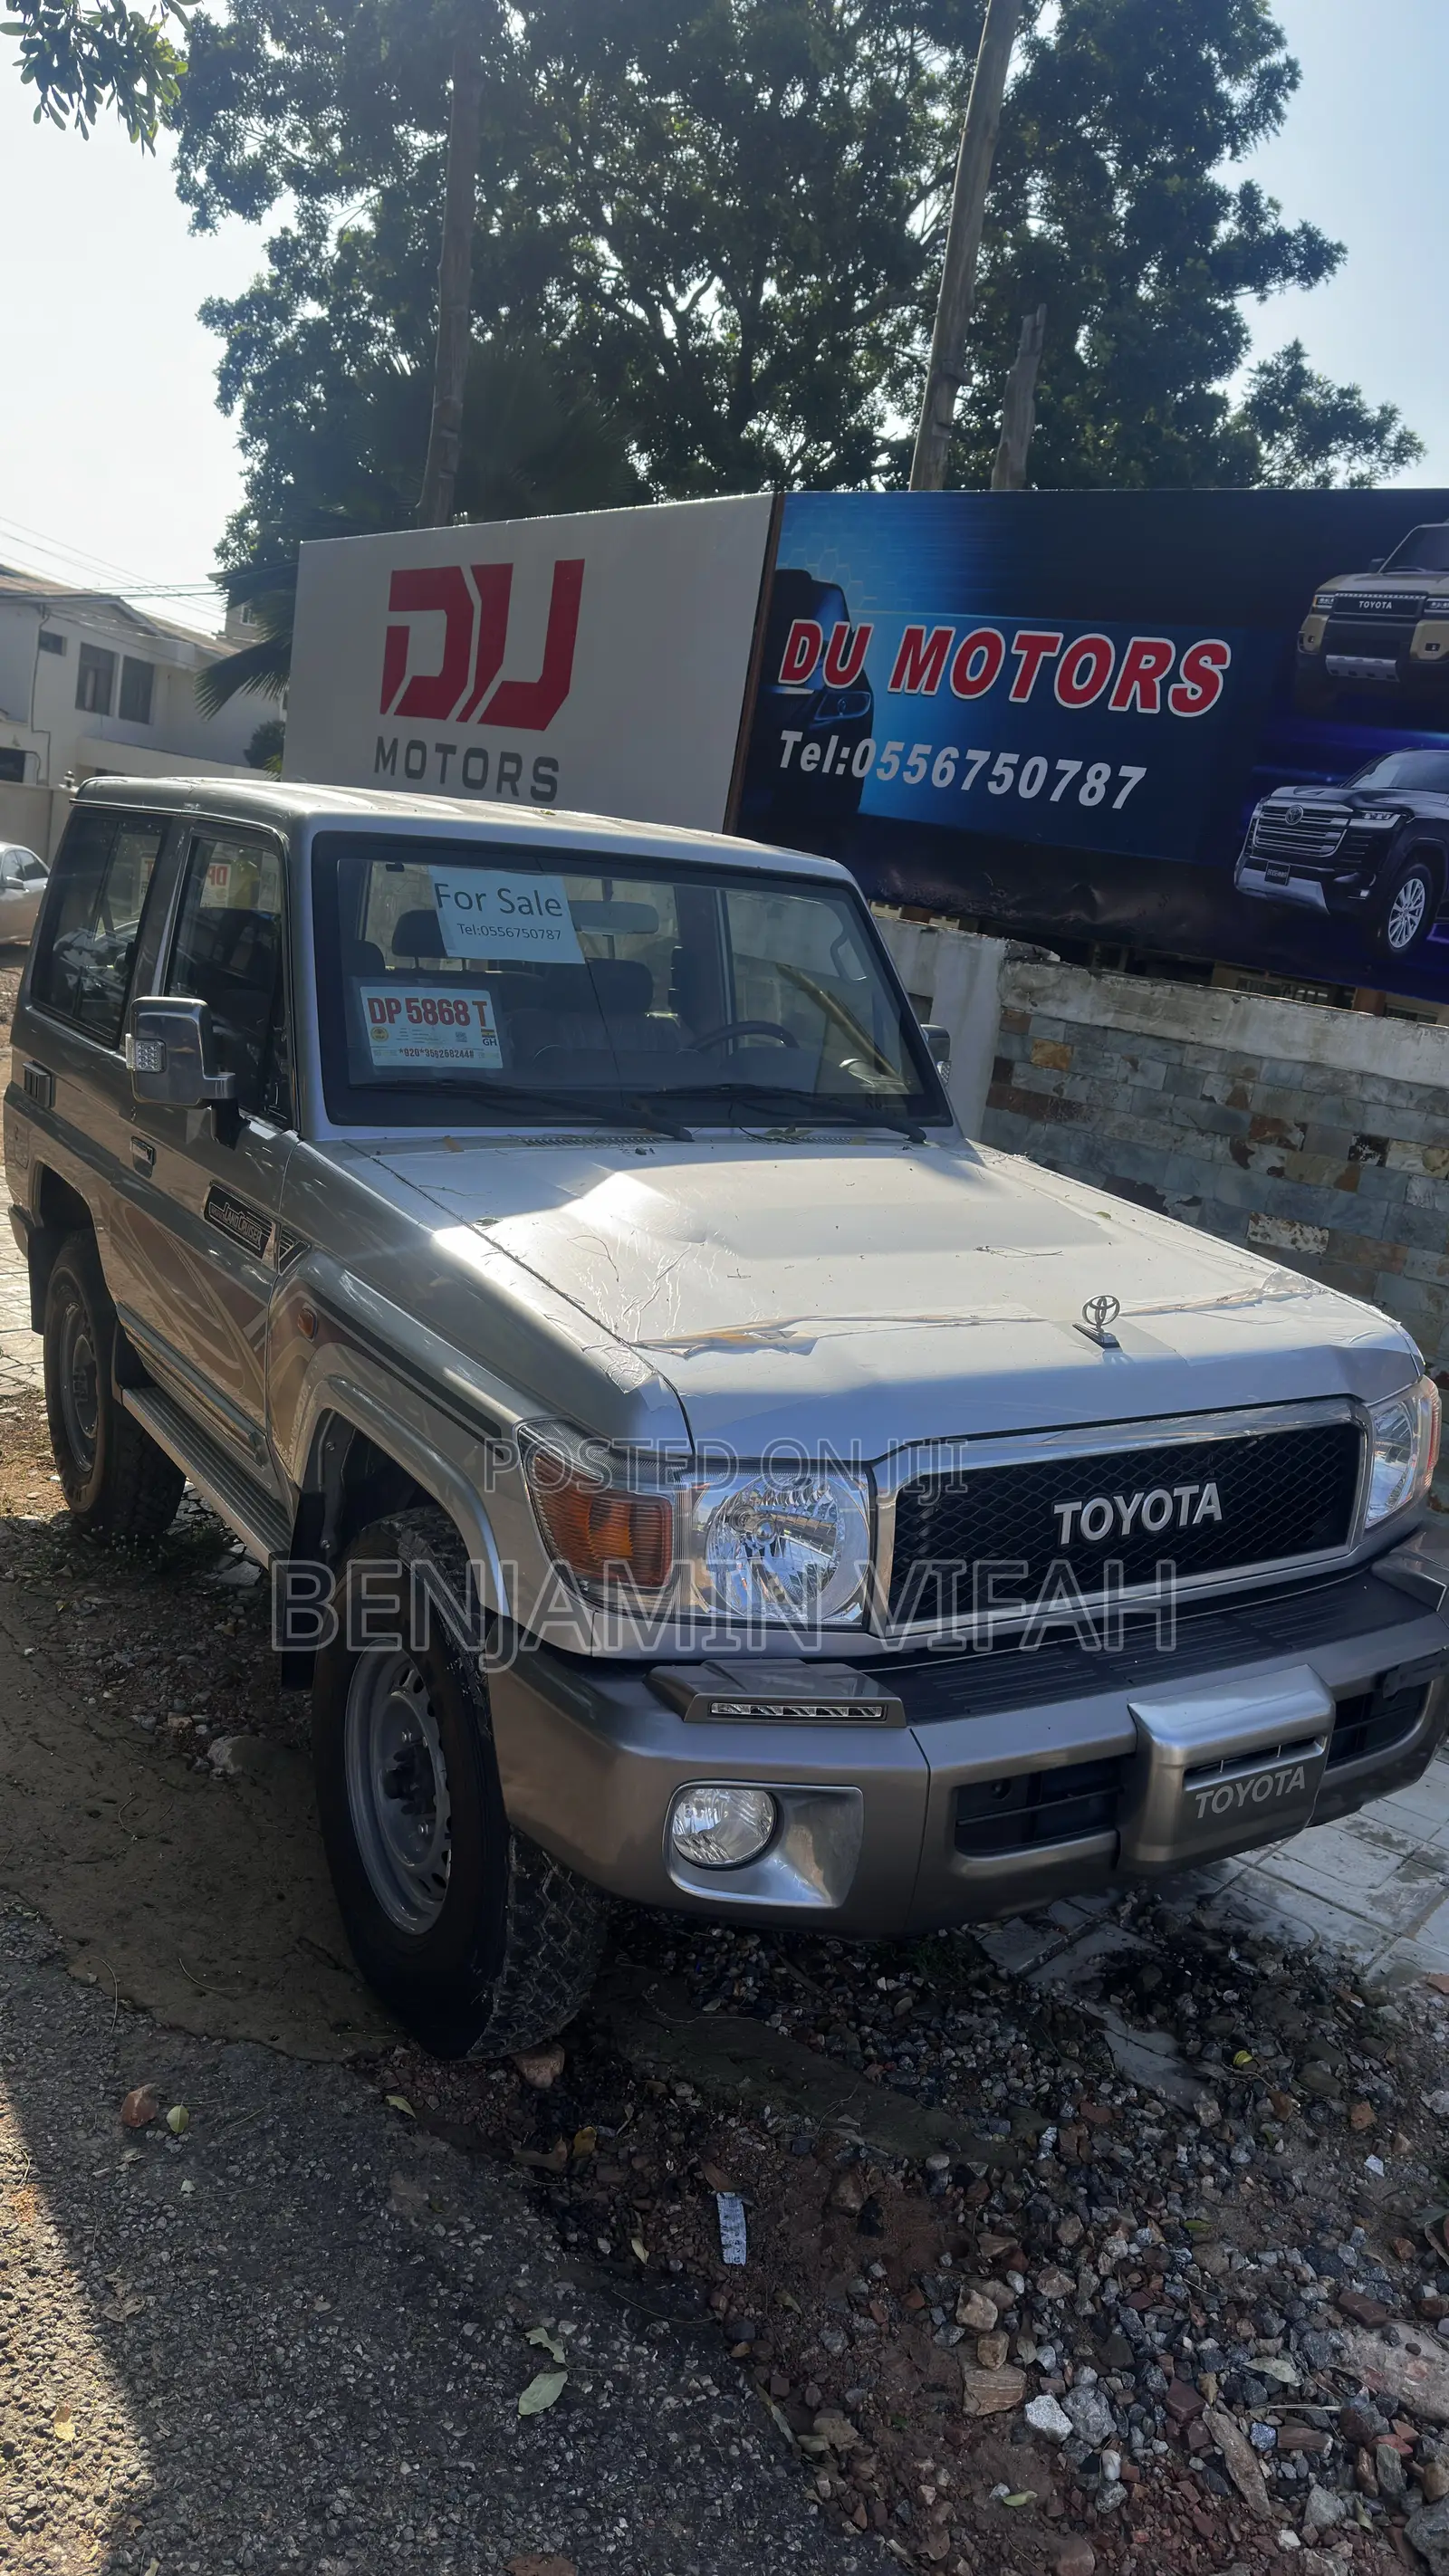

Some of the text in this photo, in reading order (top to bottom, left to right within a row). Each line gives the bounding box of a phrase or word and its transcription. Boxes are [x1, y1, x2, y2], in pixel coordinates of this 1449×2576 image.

[1358, 600, 1392, 609] TOYOTA
[778, 618, 1232, 717] DU MOTORS
[374, 736, 560, 802] MOTORS
[779, 731, 1147, 809] Tel:0556750787
[434, 883, 562, 916] For Sale
[456, 923, 561, 940] Tel:0556750787
[367, 998, 488, 1027] DP 5868 T
[482, 1038, 498, 1047] GH
[1053, 1482, 1223, 1545] TOYOTA
[1195, 1767, 1306, 1819] TOYOTA
